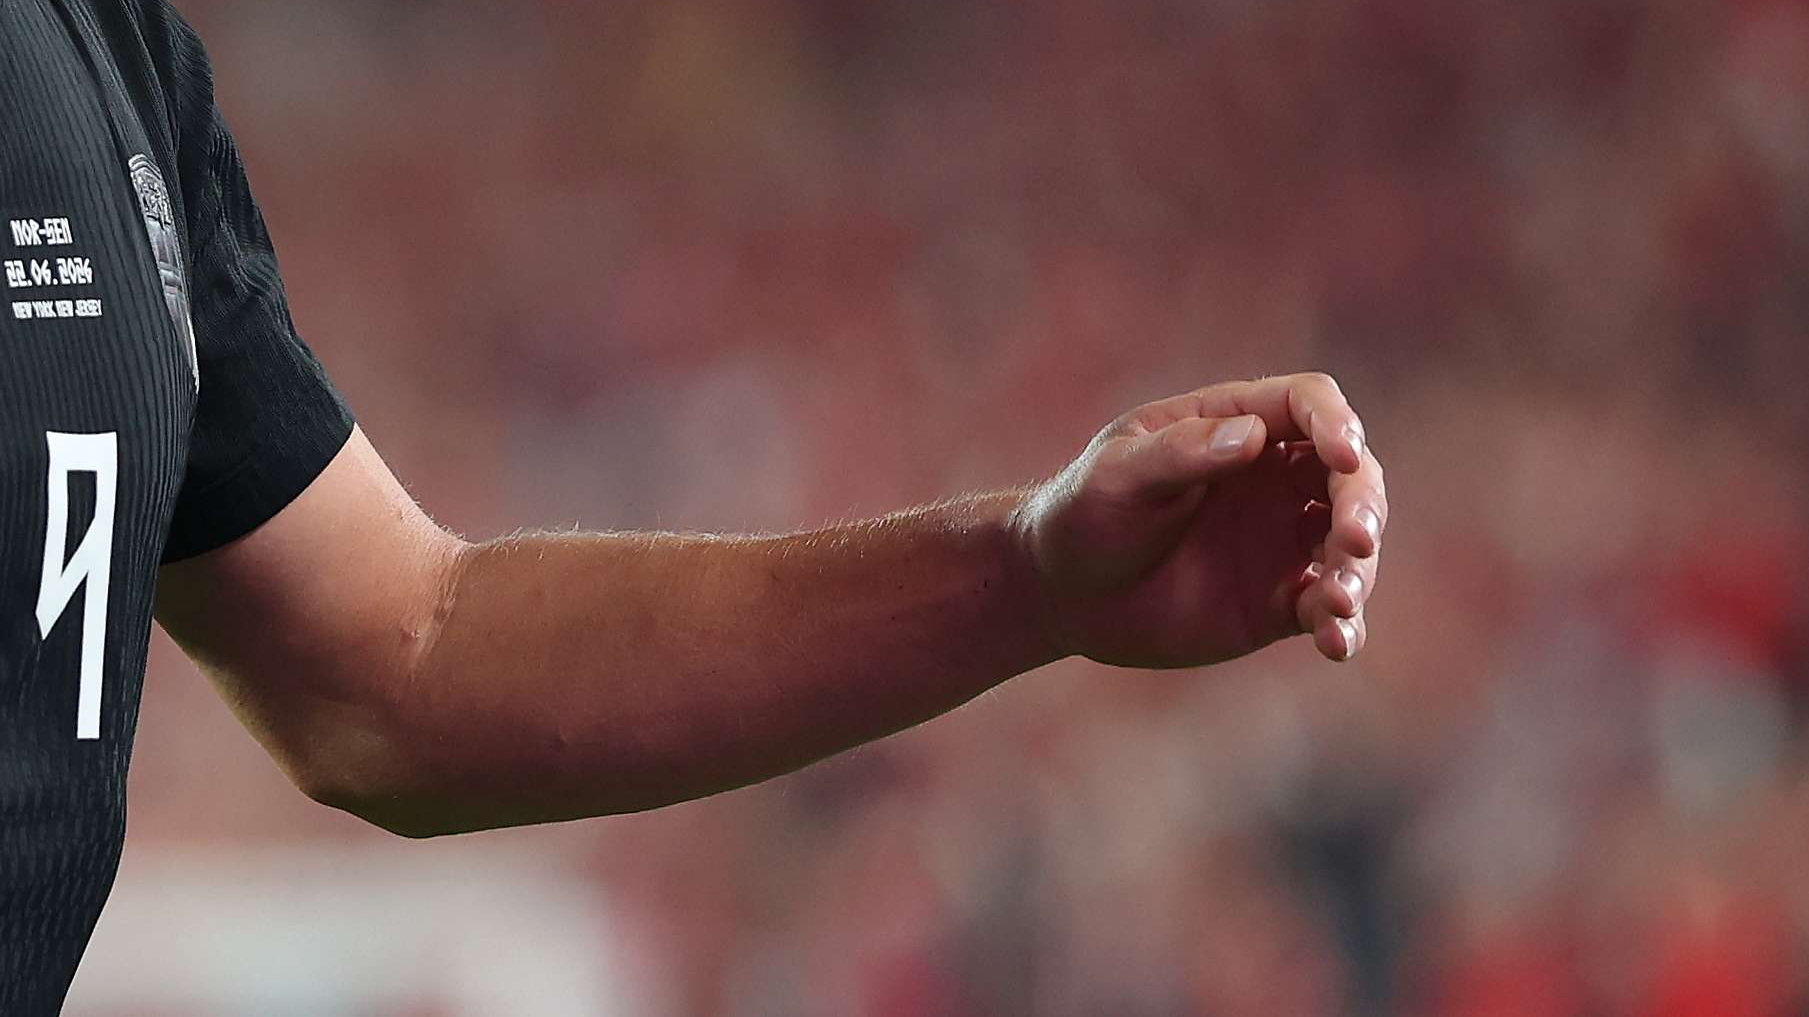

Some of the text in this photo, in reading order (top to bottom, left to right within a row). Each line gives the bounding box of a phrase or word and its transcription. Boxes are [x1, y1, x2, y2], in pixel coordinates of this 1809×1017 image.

[9, 217, 73, 246] NOR-SEN
[3, 256, 93, 288] 22.06.2026
[35, 430, 118, 740] 9
